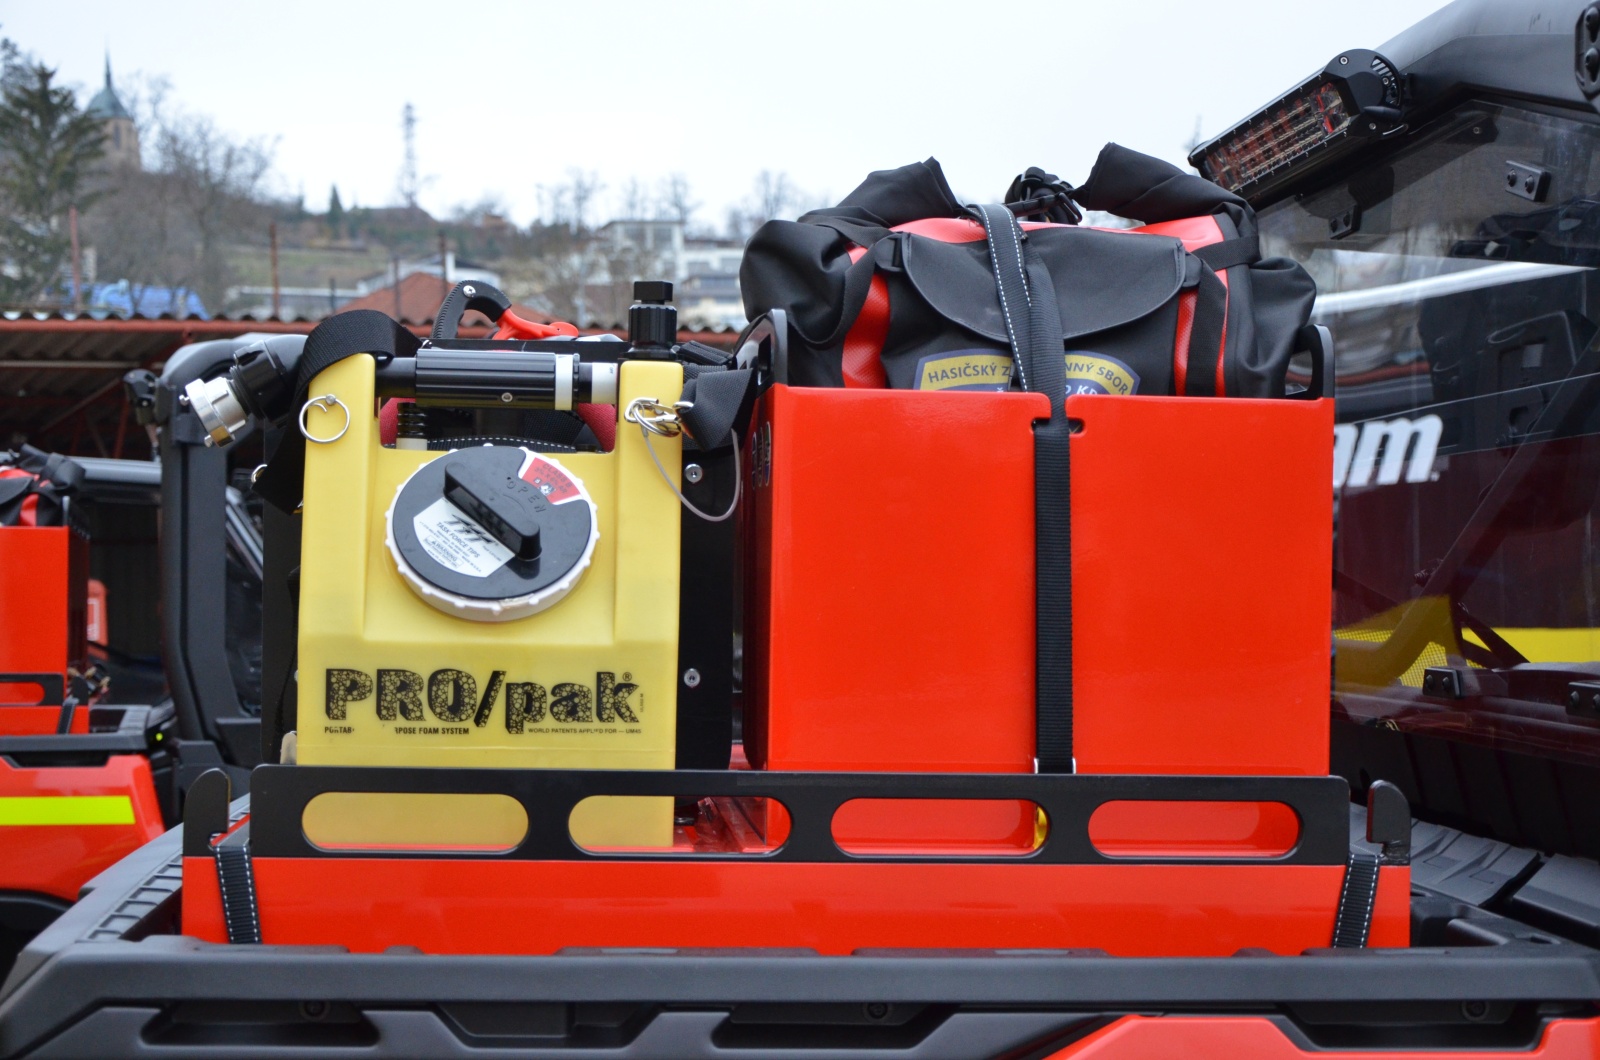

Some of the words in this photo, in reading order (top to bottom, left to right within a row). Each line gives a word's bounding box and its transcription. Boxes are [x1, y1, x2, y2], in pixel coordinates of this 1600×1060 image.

[928, 362, 997, 383] HASIČSKÝ
[1096, 366, 1128, 395] SBOR
[543, 464, 566, 482] CLASS
[506, 481, 546, 512] OPEN
[435, 542, 457, 561] WARNING
[436, 522, 451, 535] TASK
[450, 532, 469, 548] FORCE
[467, 546, 480, 558] TIPS
